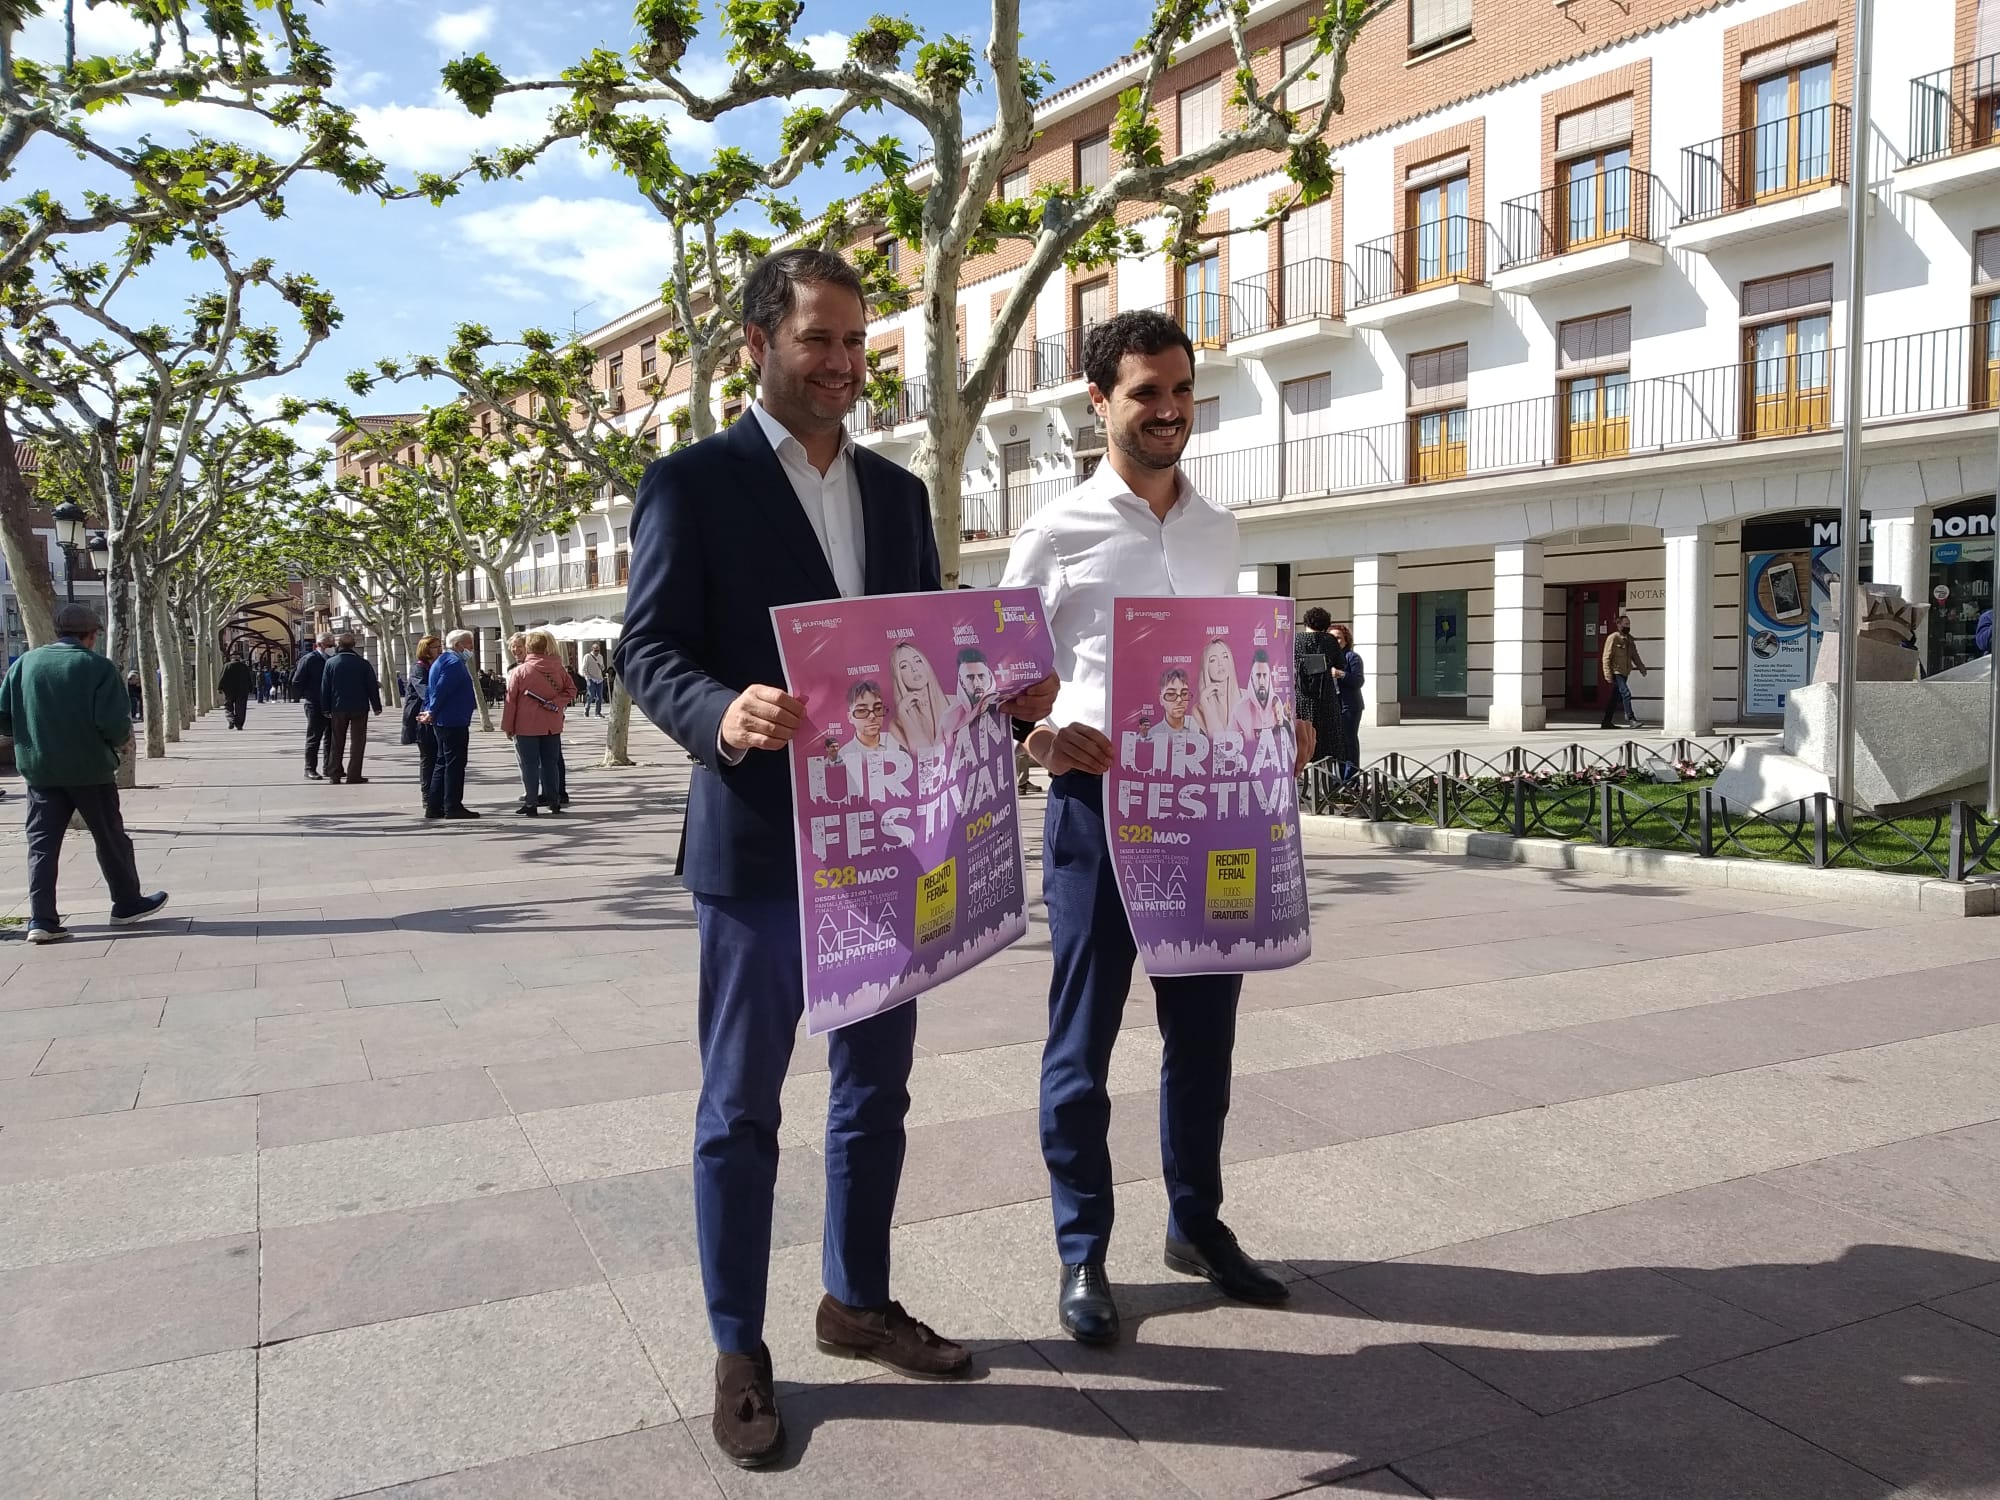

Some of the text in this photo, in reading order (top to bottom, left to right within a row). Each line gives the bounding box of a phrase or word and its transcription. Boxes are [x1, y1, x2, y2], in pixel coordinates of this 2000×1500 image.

[886, 630, 897, 640] ANA
[1010, 660, 1037, 671] artista
[1012, 669, 1042, 682] invitado
[807, 711, 1007, 809] URBAN
[1120, 727, 1297, 779] URBAN
[810, 754, 1010, 862] FESTIVAL
[966, 803, 1011, 843] D29 MAYO
[1119, 825, 1191, 845] S28 MAYO
[968, 836, 1013, 874] ARTISTA INVITADO
[1215, 853, 1250, 867] RECINTO
[813, 865, 899, 888] S28 MAYO
[923, 864, 952, 891] RECINTO
[1124, 864, 1187, 882] ANA
[1218, 868, 1247, 881] FERIAL
[926, 881, 949, 903] FERIAL
[968, 866, 1014, 909] JUANCHO
[969, 876, 987, 894] CRUZ
[1126, 882, 1186, 901] MENA
[1223, 887, 1241, 897] TODOS
[1271, 881, 1289, 894] CRUZ
[814, 895, 836, 903] DESDE
[967, 880, 1016, 922] MARQUES
[1130, 900, 1187, 912] DON PATRICIO
[816, 901, 897, 934] ANA
[1212, 911, 1249, 920] GRATUITOS
[818, 920, 896, 953] MENA
[920, 922, 952, 945] GRATUITOS
[818, 937, 896, 966] DON PATRICIO
